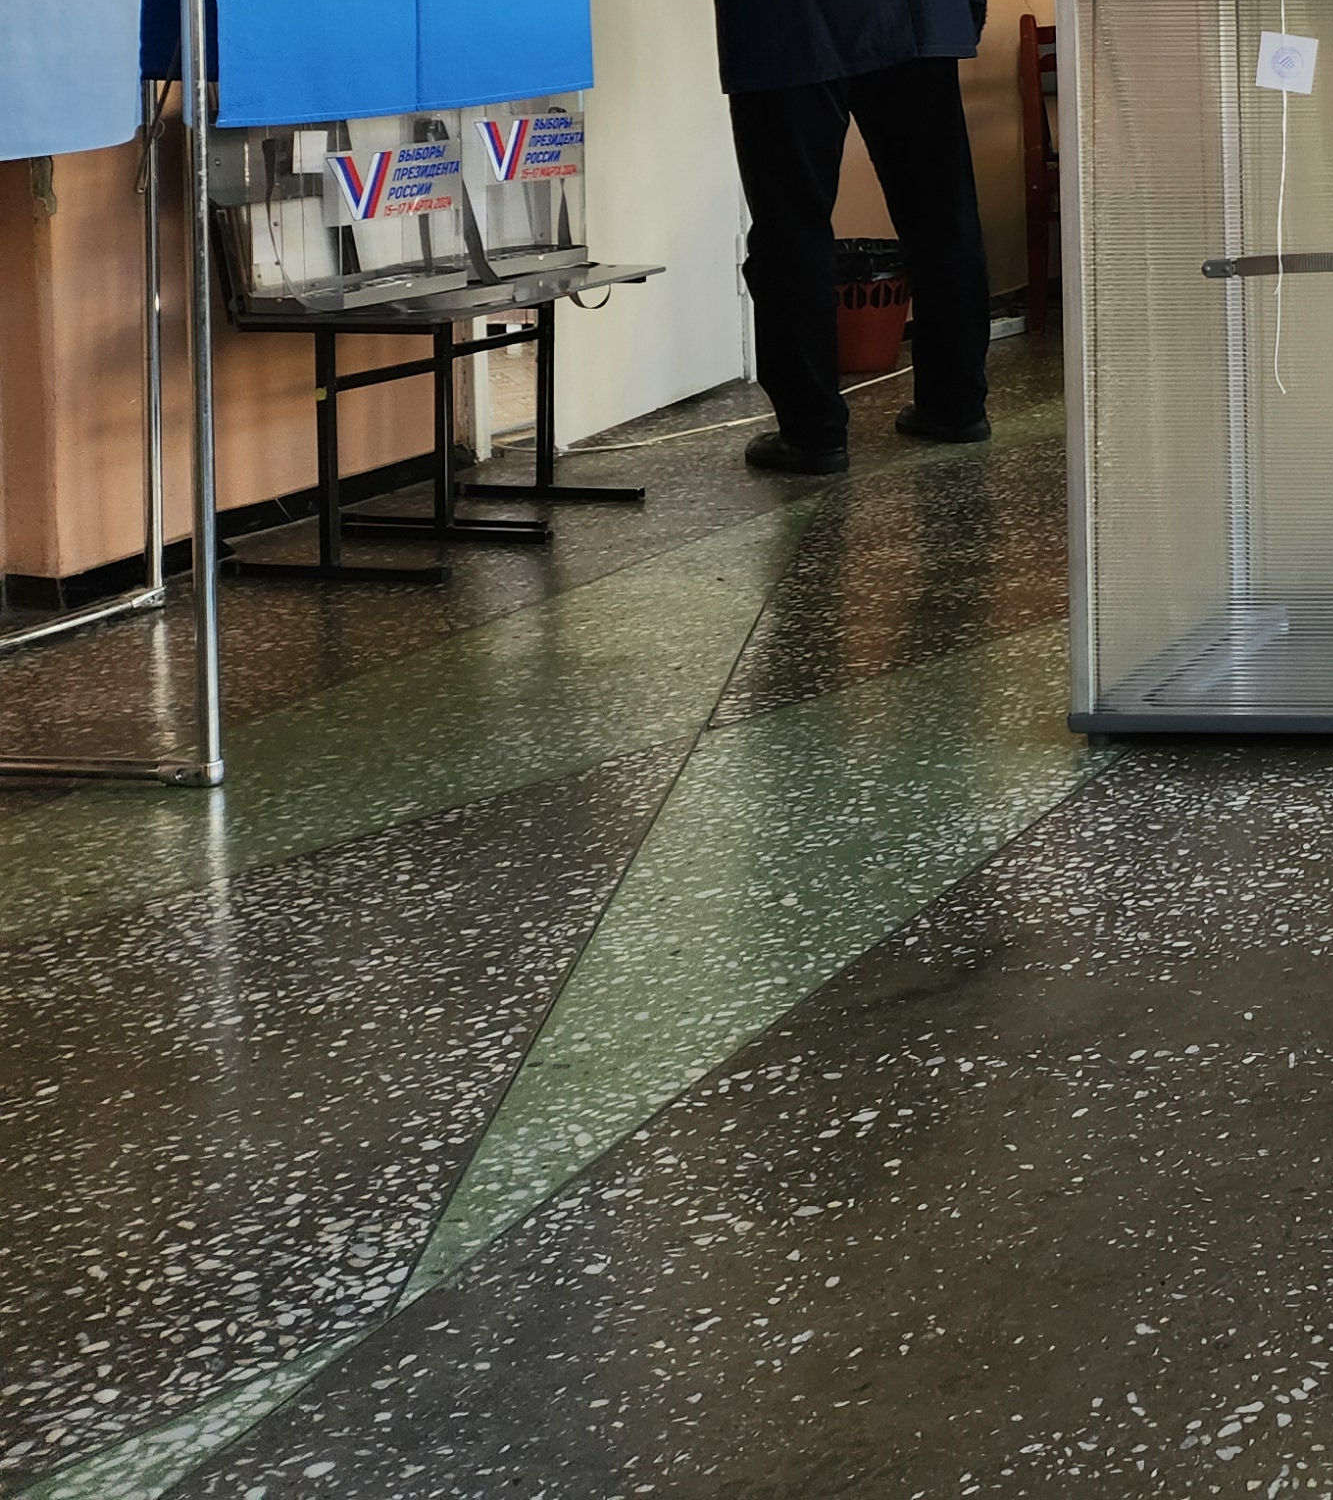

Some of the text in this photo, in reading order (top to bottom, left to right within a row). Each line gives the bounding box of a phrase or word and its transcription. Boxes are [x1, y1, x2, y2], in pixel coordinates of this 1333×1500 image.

[533, 117, 574, 131] ВЫБОРЫ
[528, 131, 584, 148] ПРЕЗИДЕНТА
[397, 145, 446, 163] ВЫБОРЫ
[524, 150, 561, 165] РОССИИ
[392, 161, 460, 181] ПРЕЗИДЕНТА
[387, 182, 433, 200] РОССИИ
